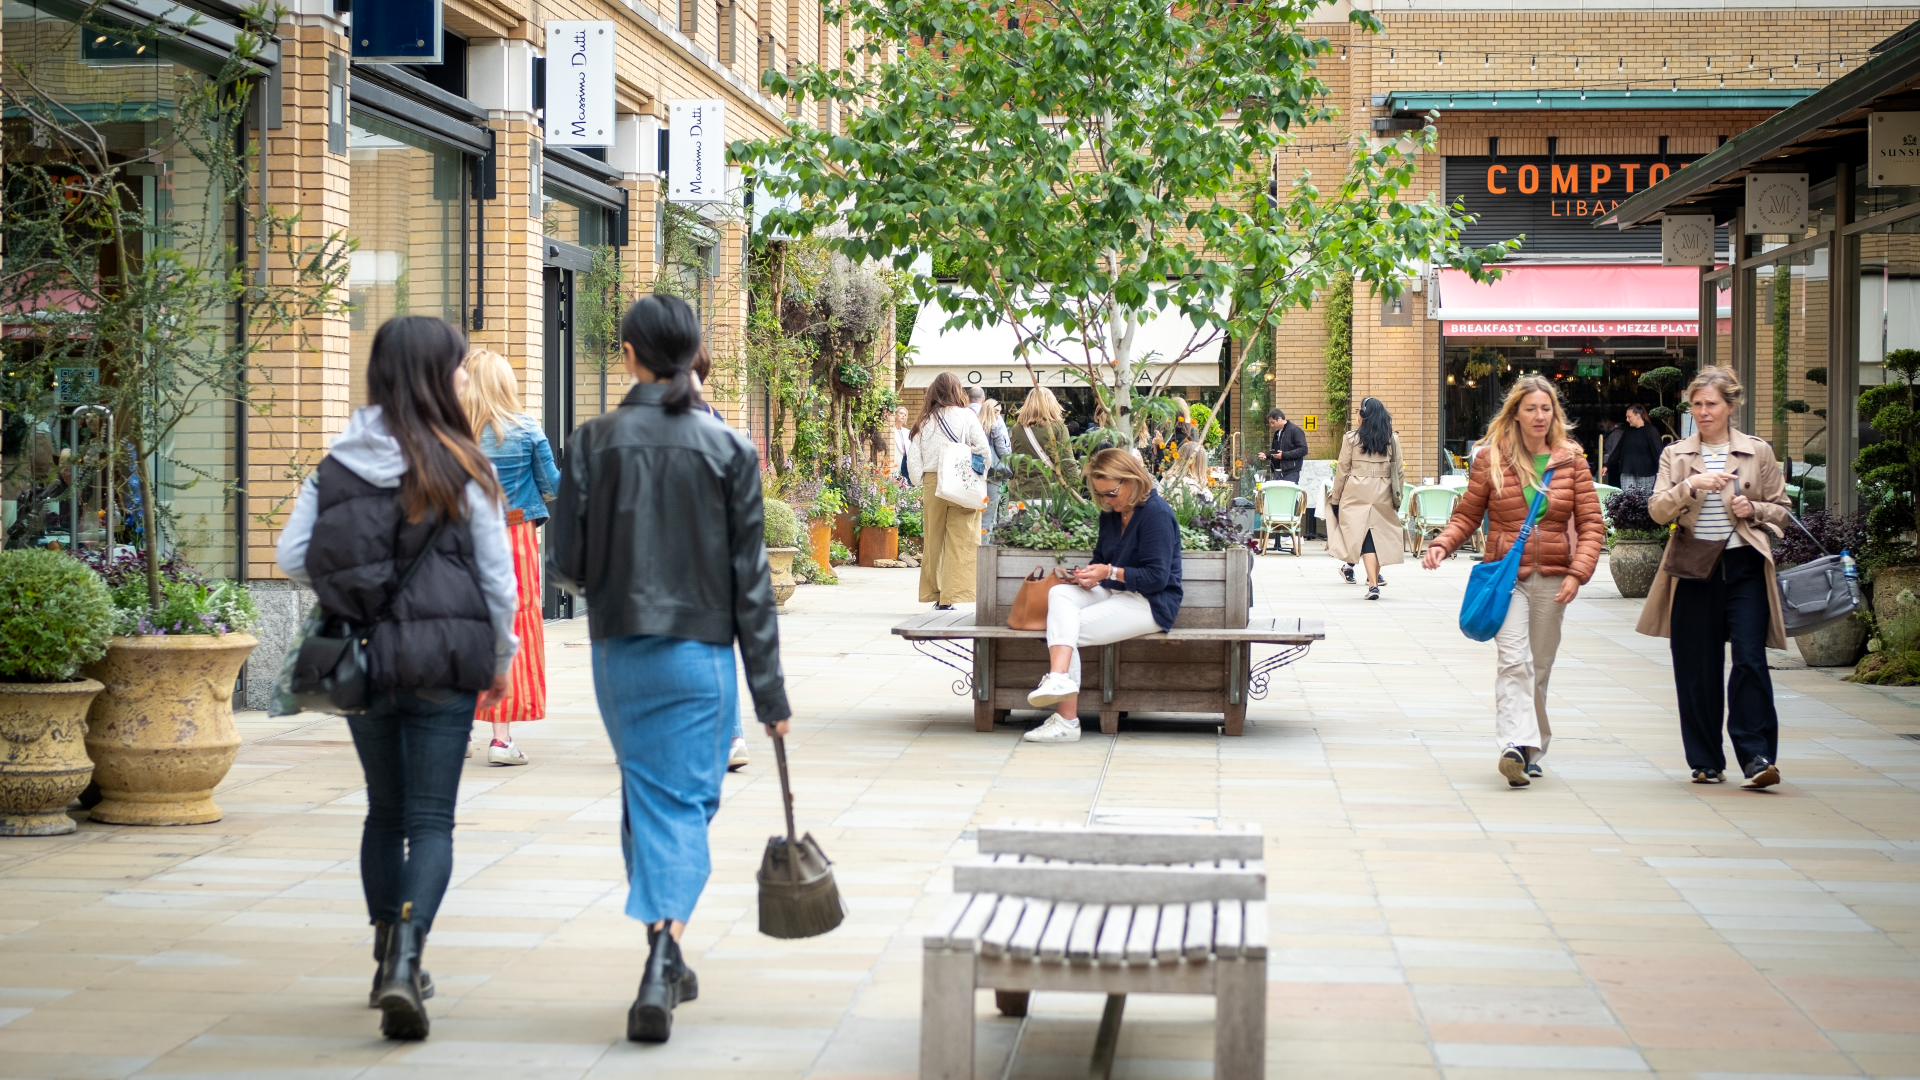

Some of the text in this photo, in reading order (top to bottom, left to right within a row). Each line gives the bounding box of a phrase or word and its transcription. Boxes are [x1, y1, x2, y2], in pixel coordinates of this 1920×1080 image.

[571, 28, 587, 137] Massimo Dutti
[690, 106, 703, 194] Massimo Dutti
[1487, 163, 1692, 194] COMPTO
[1451, 323, 1699, 333] BREAKFAST COCKTAILS MEZZE PLATT
[967, 370, 1153, 384] ORTIA
[1305, 416, 1316, 430] H
